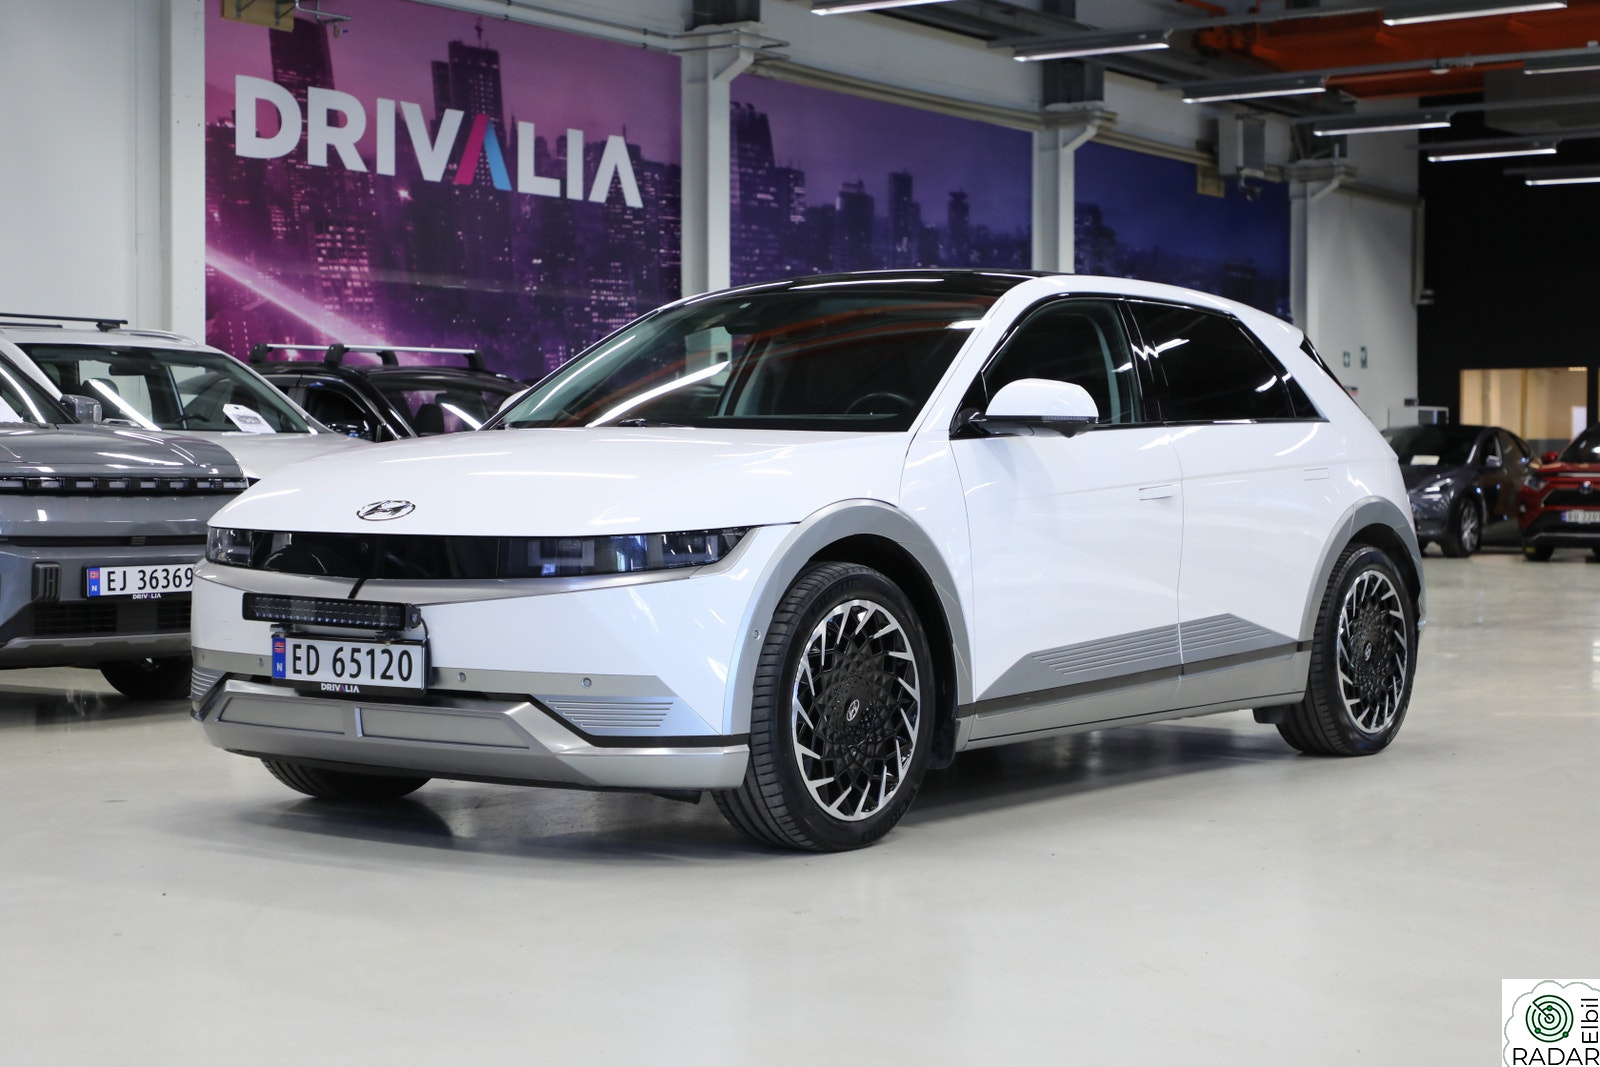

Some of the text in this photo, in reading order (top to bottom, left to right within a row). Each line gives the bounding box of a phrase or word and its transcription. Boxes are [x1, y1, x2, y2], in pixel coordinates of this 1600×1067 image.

[235, 74, 643, 208] DRIVALIA
[107, 570, 127, 591] EJ
[137, 567, 193, 590] 36369
[276, 644, 413, 682] N ED 65120
[320, 682, 360, 694] DRIVALIA
